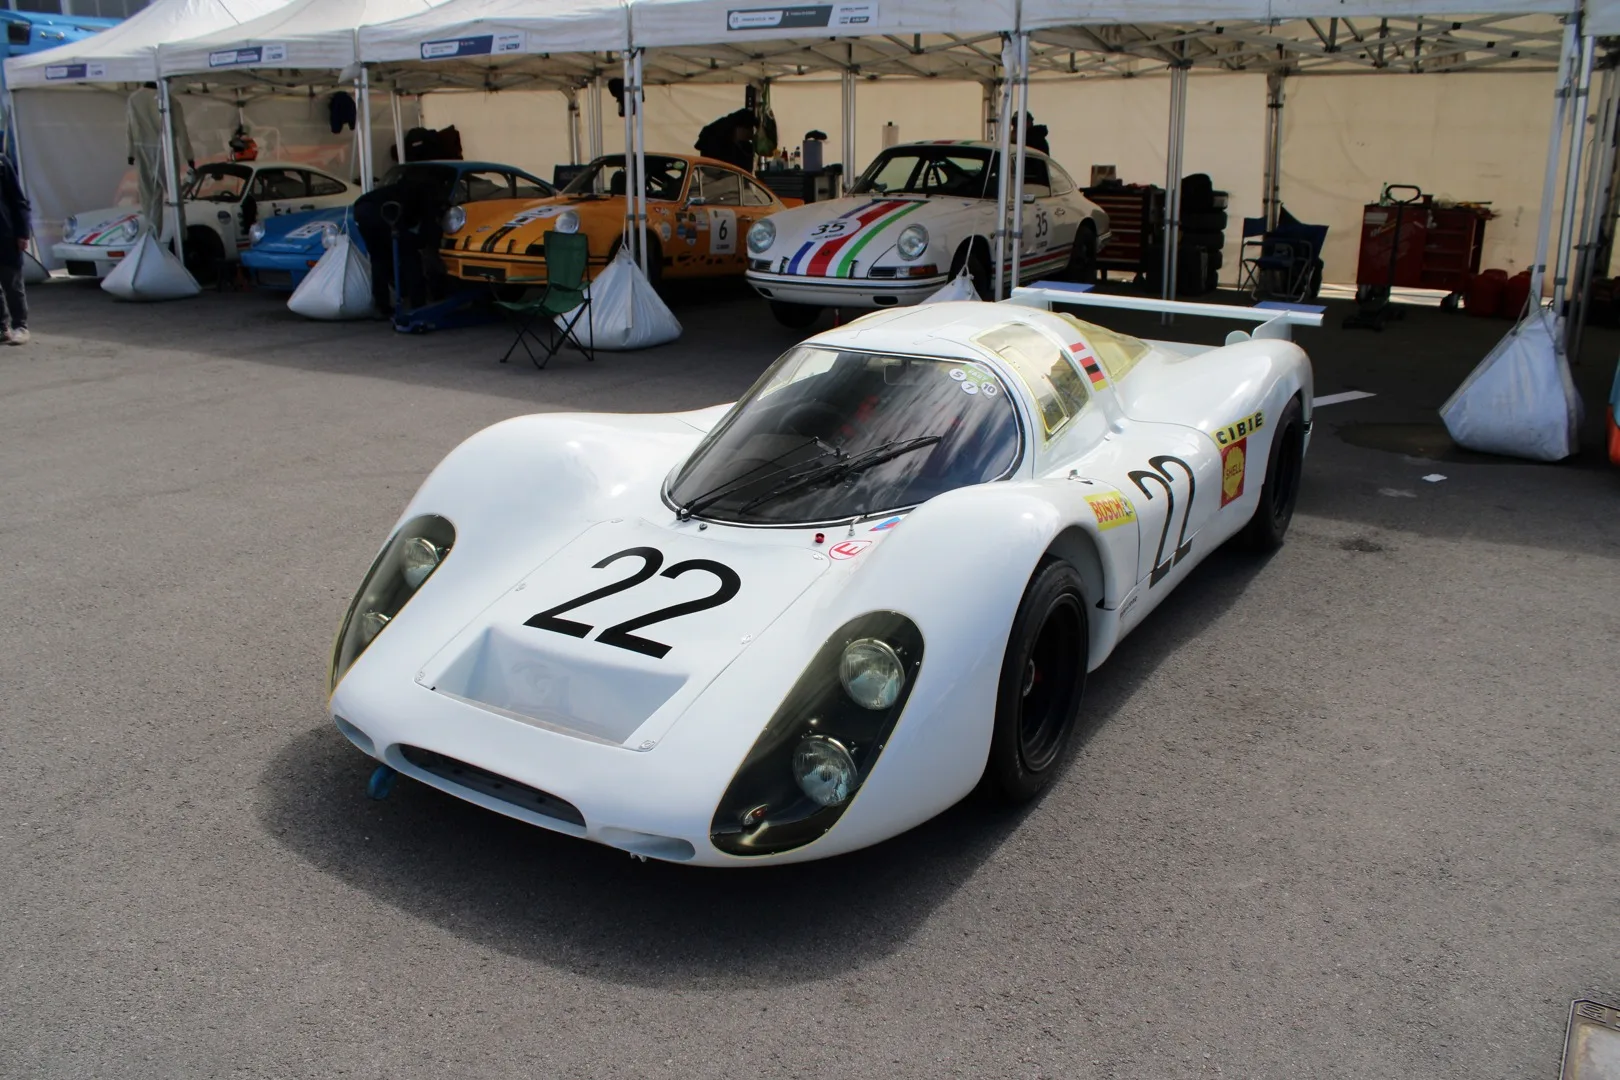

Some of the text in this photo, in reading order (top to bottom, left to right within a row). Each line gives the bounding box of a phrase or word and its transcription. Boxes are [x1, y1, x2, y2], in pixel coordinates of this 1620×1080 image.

[719, 219, 728, 240] 6
[810, 221, 848, 236] 35
[1035, 211, 1048, 238] 35
[983, 383, 996, 393] 10
[1216, 412, 1263, 445] CIBIE
[1226, 463, 1242, 480] SHELL
[1089, 496, 1126, 524] BOSCH
[1127, 454, 1196, 590] 22
[833, 542, 859, 556] E
[522, 546, 742, 660] 22
